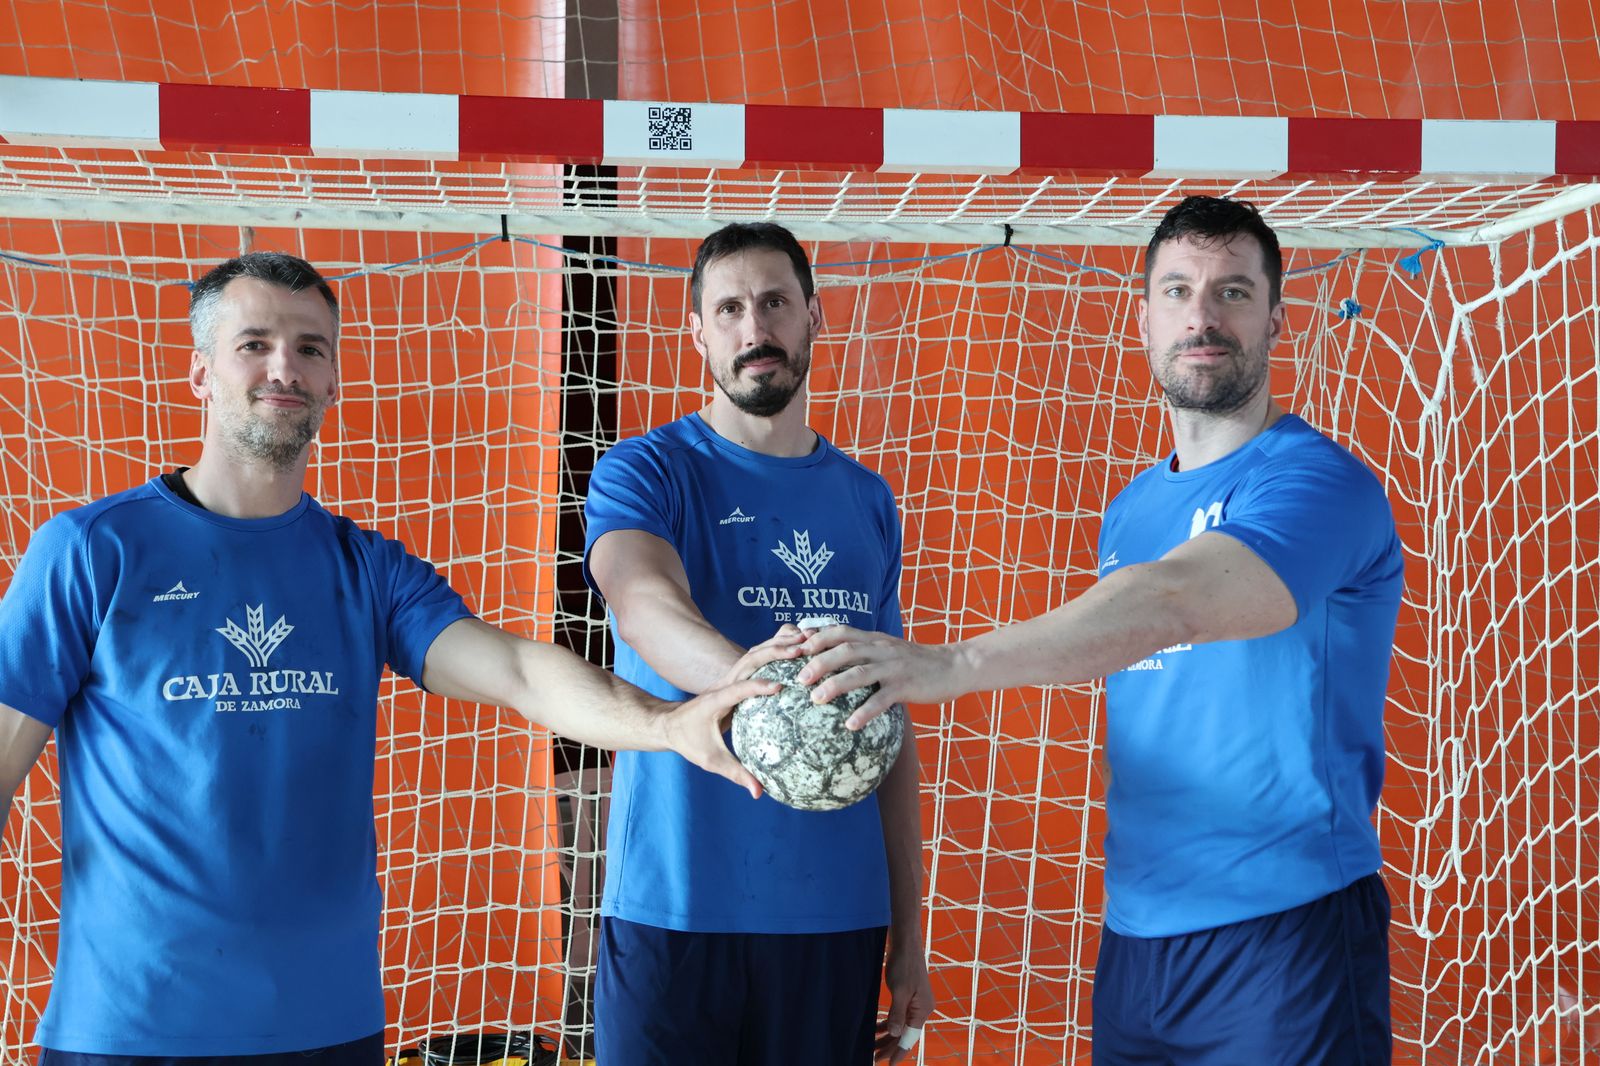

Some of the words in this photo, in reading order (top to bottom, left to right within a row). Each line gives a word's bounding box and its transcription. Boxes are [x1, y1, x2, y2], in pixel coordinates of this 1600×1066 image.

[719, 515, 755, 525] MERCURY
[153, 591, 200, 602] MERCURY
[737, 586, 795, 609] CAJA
[802, 588, 872, 614] RURAL
[774, 612, 791, 622] DE
[162, 672, 241, 701] CAJA
[250, 669, 339, 695] RURAL
[215, 701, 236, 712] DE
[241, 698, 301, 712] ZAMORA
